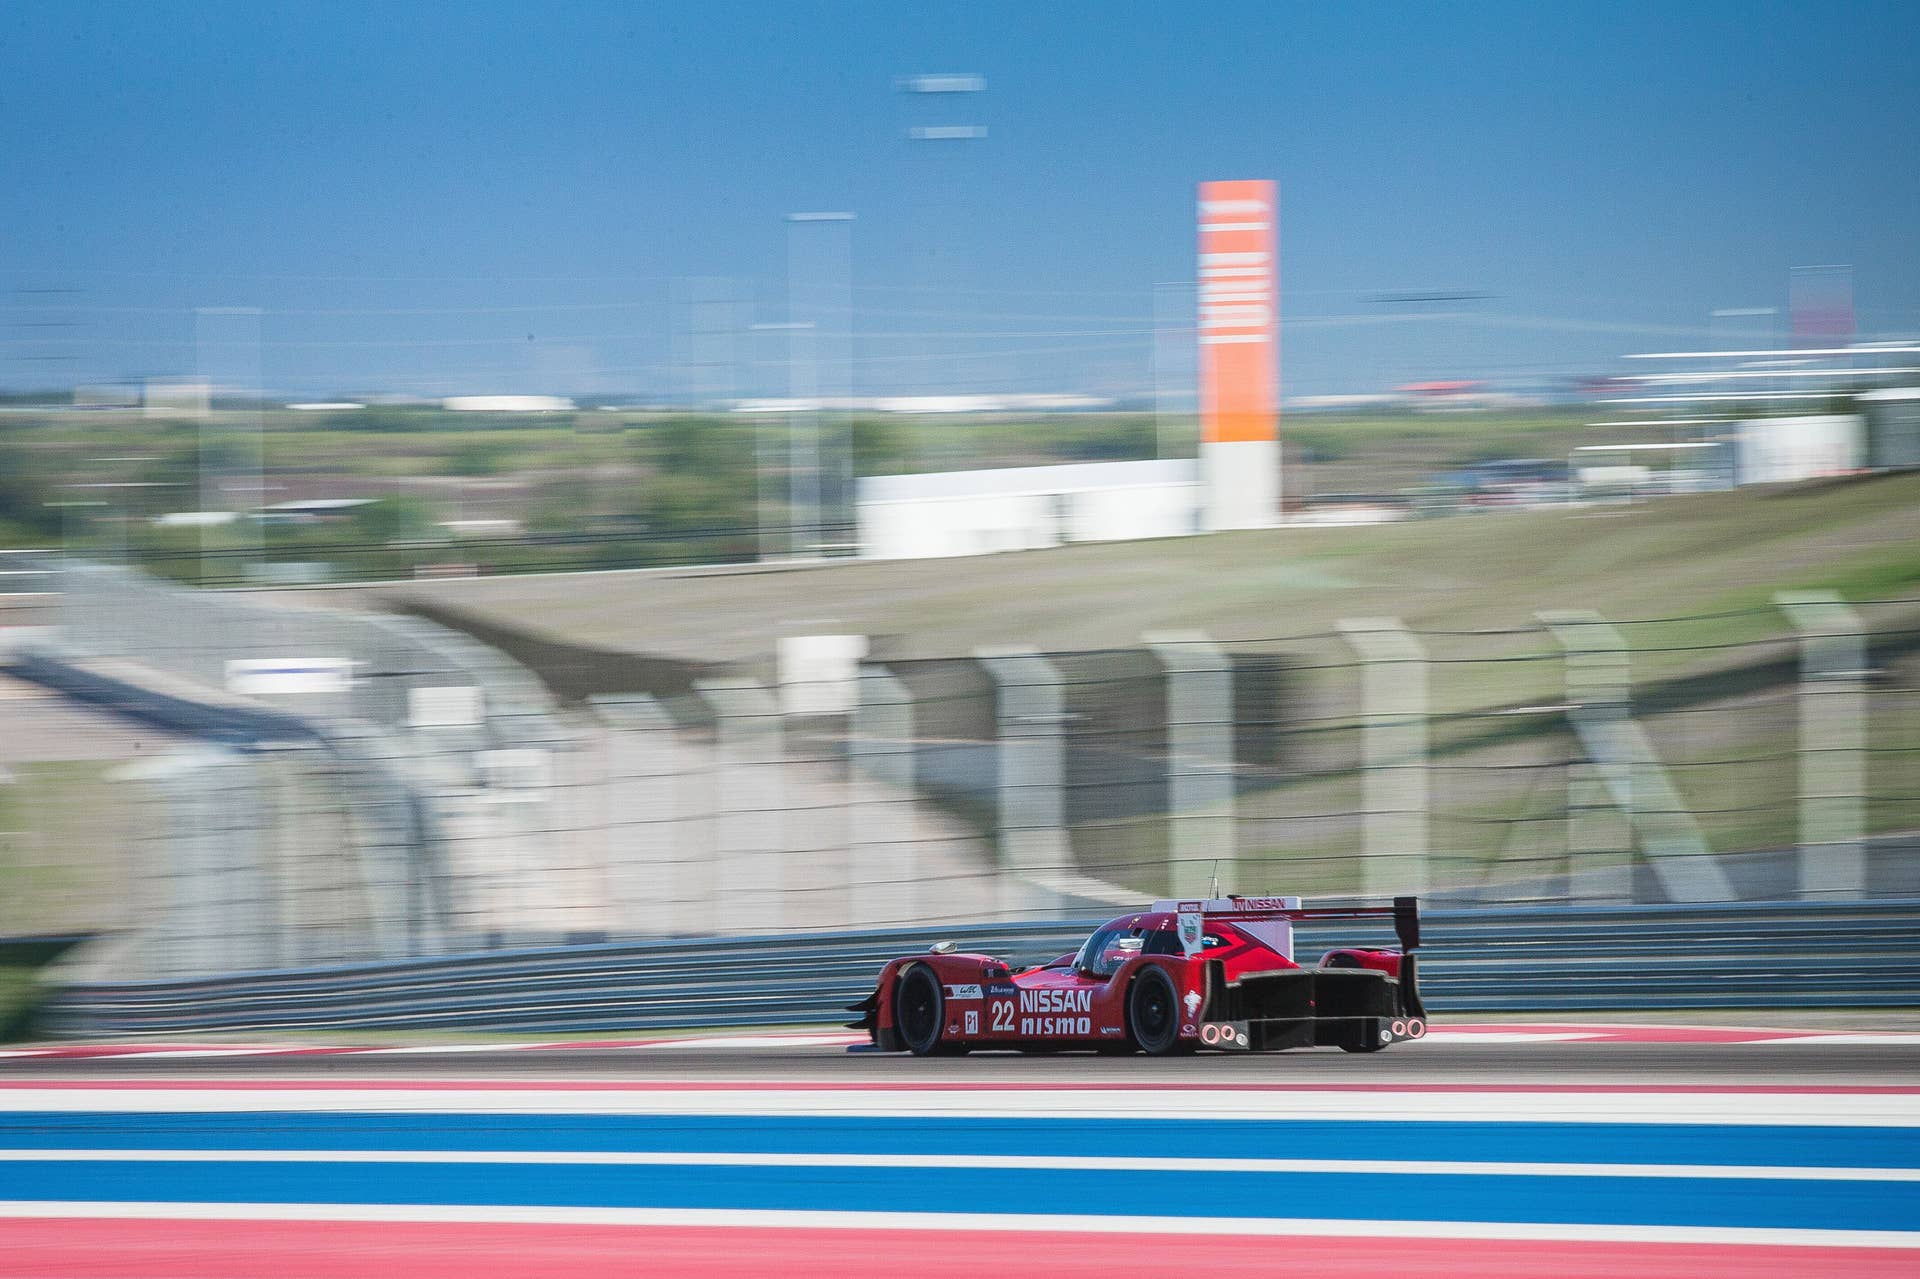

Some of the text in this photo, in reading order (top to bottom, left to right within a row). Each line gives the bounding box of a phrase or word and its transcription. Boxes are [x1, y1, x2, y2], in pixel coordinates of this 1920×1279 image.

[1247, 899, 1286, 910] NISSAN
[1020, 989, 1092, 1012] NISSAN
[967, 1014, 977, 1031] P1
[992, 1000, 1015, 1031] 22
[1021, 1017, 1091, 1035] nismo
